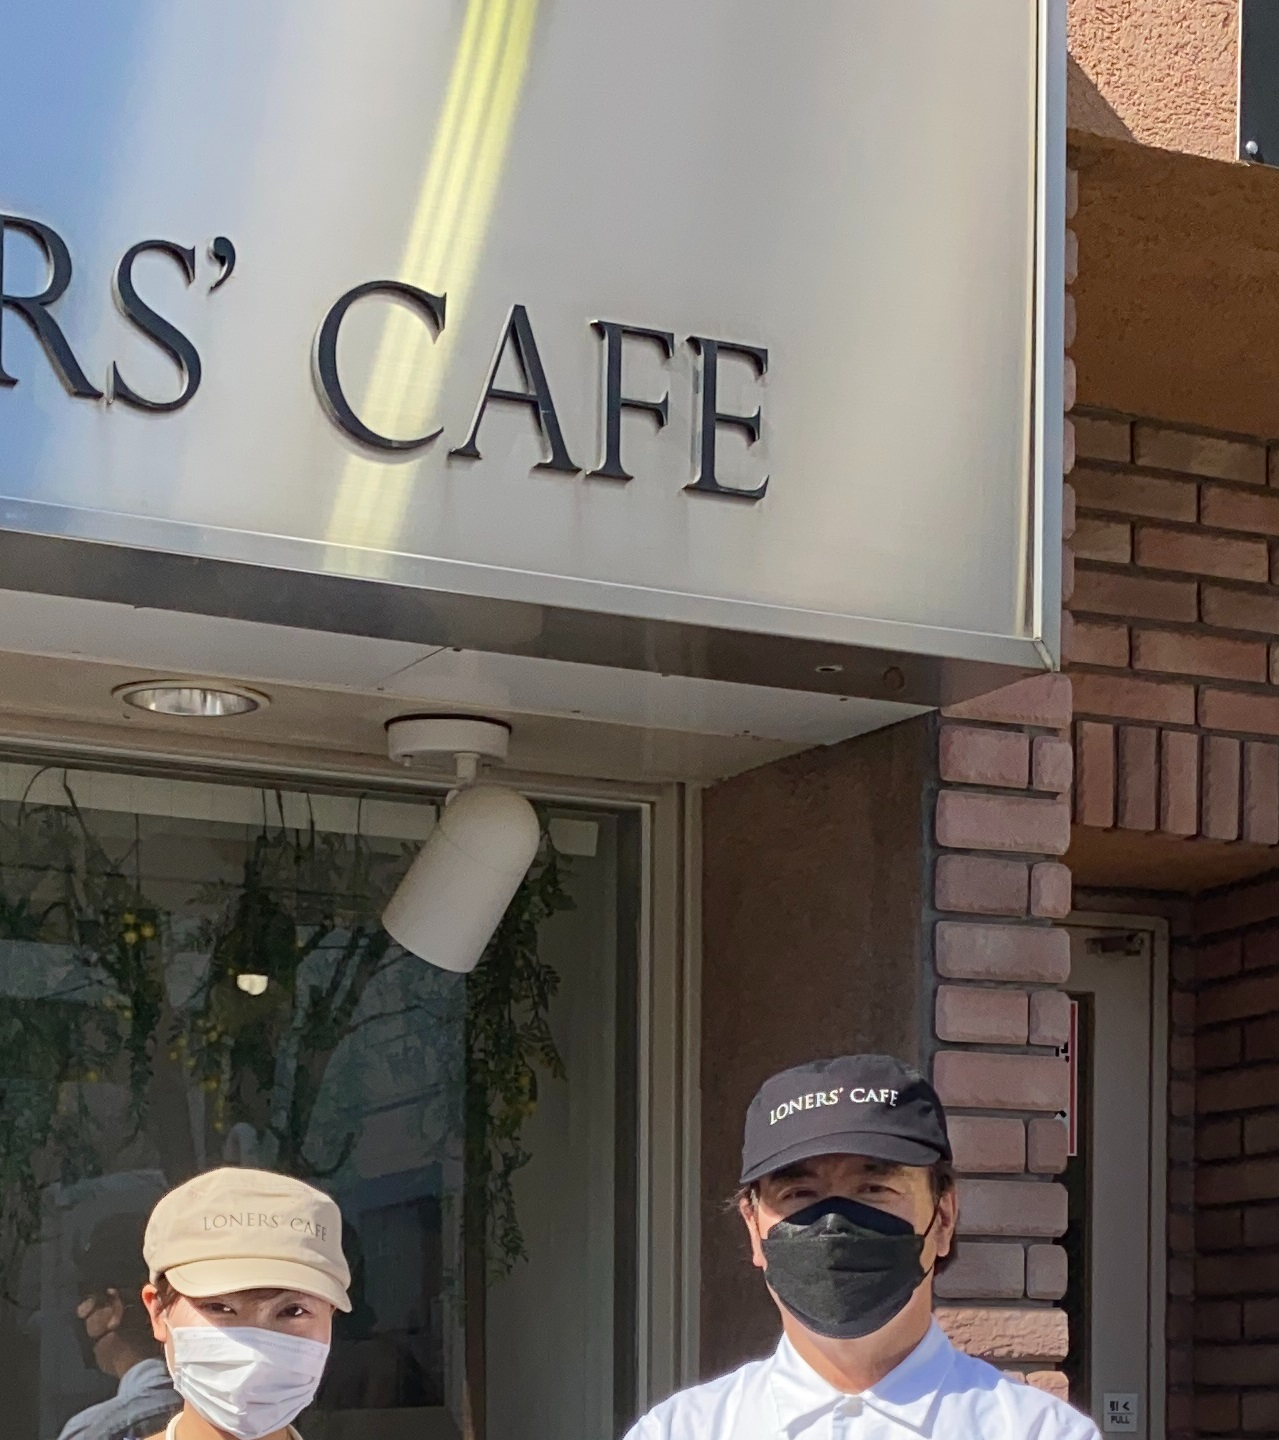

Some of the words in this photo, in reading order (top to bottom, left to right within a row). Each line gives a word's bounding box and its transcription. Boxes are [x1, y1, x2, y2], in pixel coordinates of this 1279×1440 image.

[310, 278, 771, 504] CAFE
[770, 1086, 844, 1126] LONERS'
[849, 1087, 900, 1108] CAFE
[290, 1217, 327, 1242] CAFE
[1109, 1400, 1130, 1412] 引く
[1110, 1415, 1130, 1425] PULL
